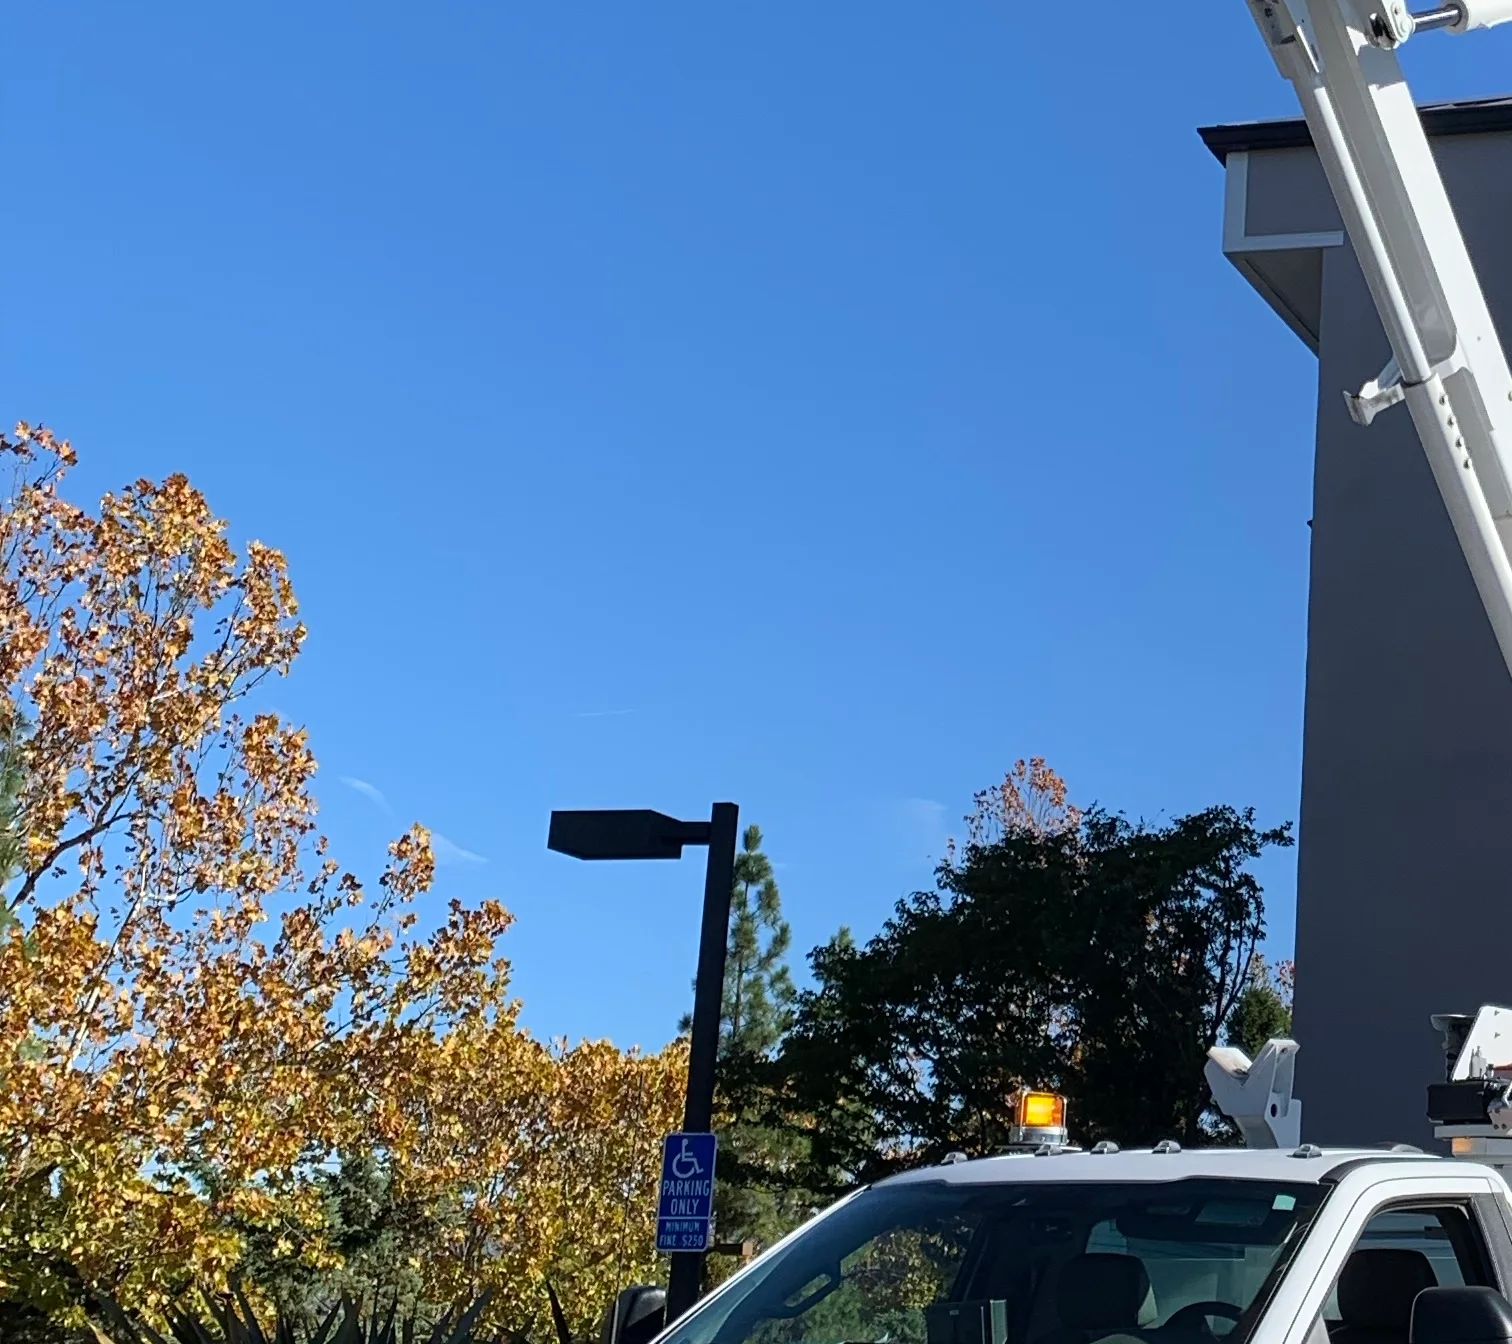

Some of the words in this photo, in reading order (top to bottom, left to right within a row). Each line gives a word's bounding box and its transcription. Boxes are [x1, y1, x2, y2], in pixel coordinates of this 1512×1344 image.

[662, 1179, 710, 1197] PARKING
[670, 1198, 700, 1216] ONLY
[665, 1221, 701, 1233] MINIMUM
[659, 1234, 677, 1247] FINE
[681, 1234, 704, 1247] $250
